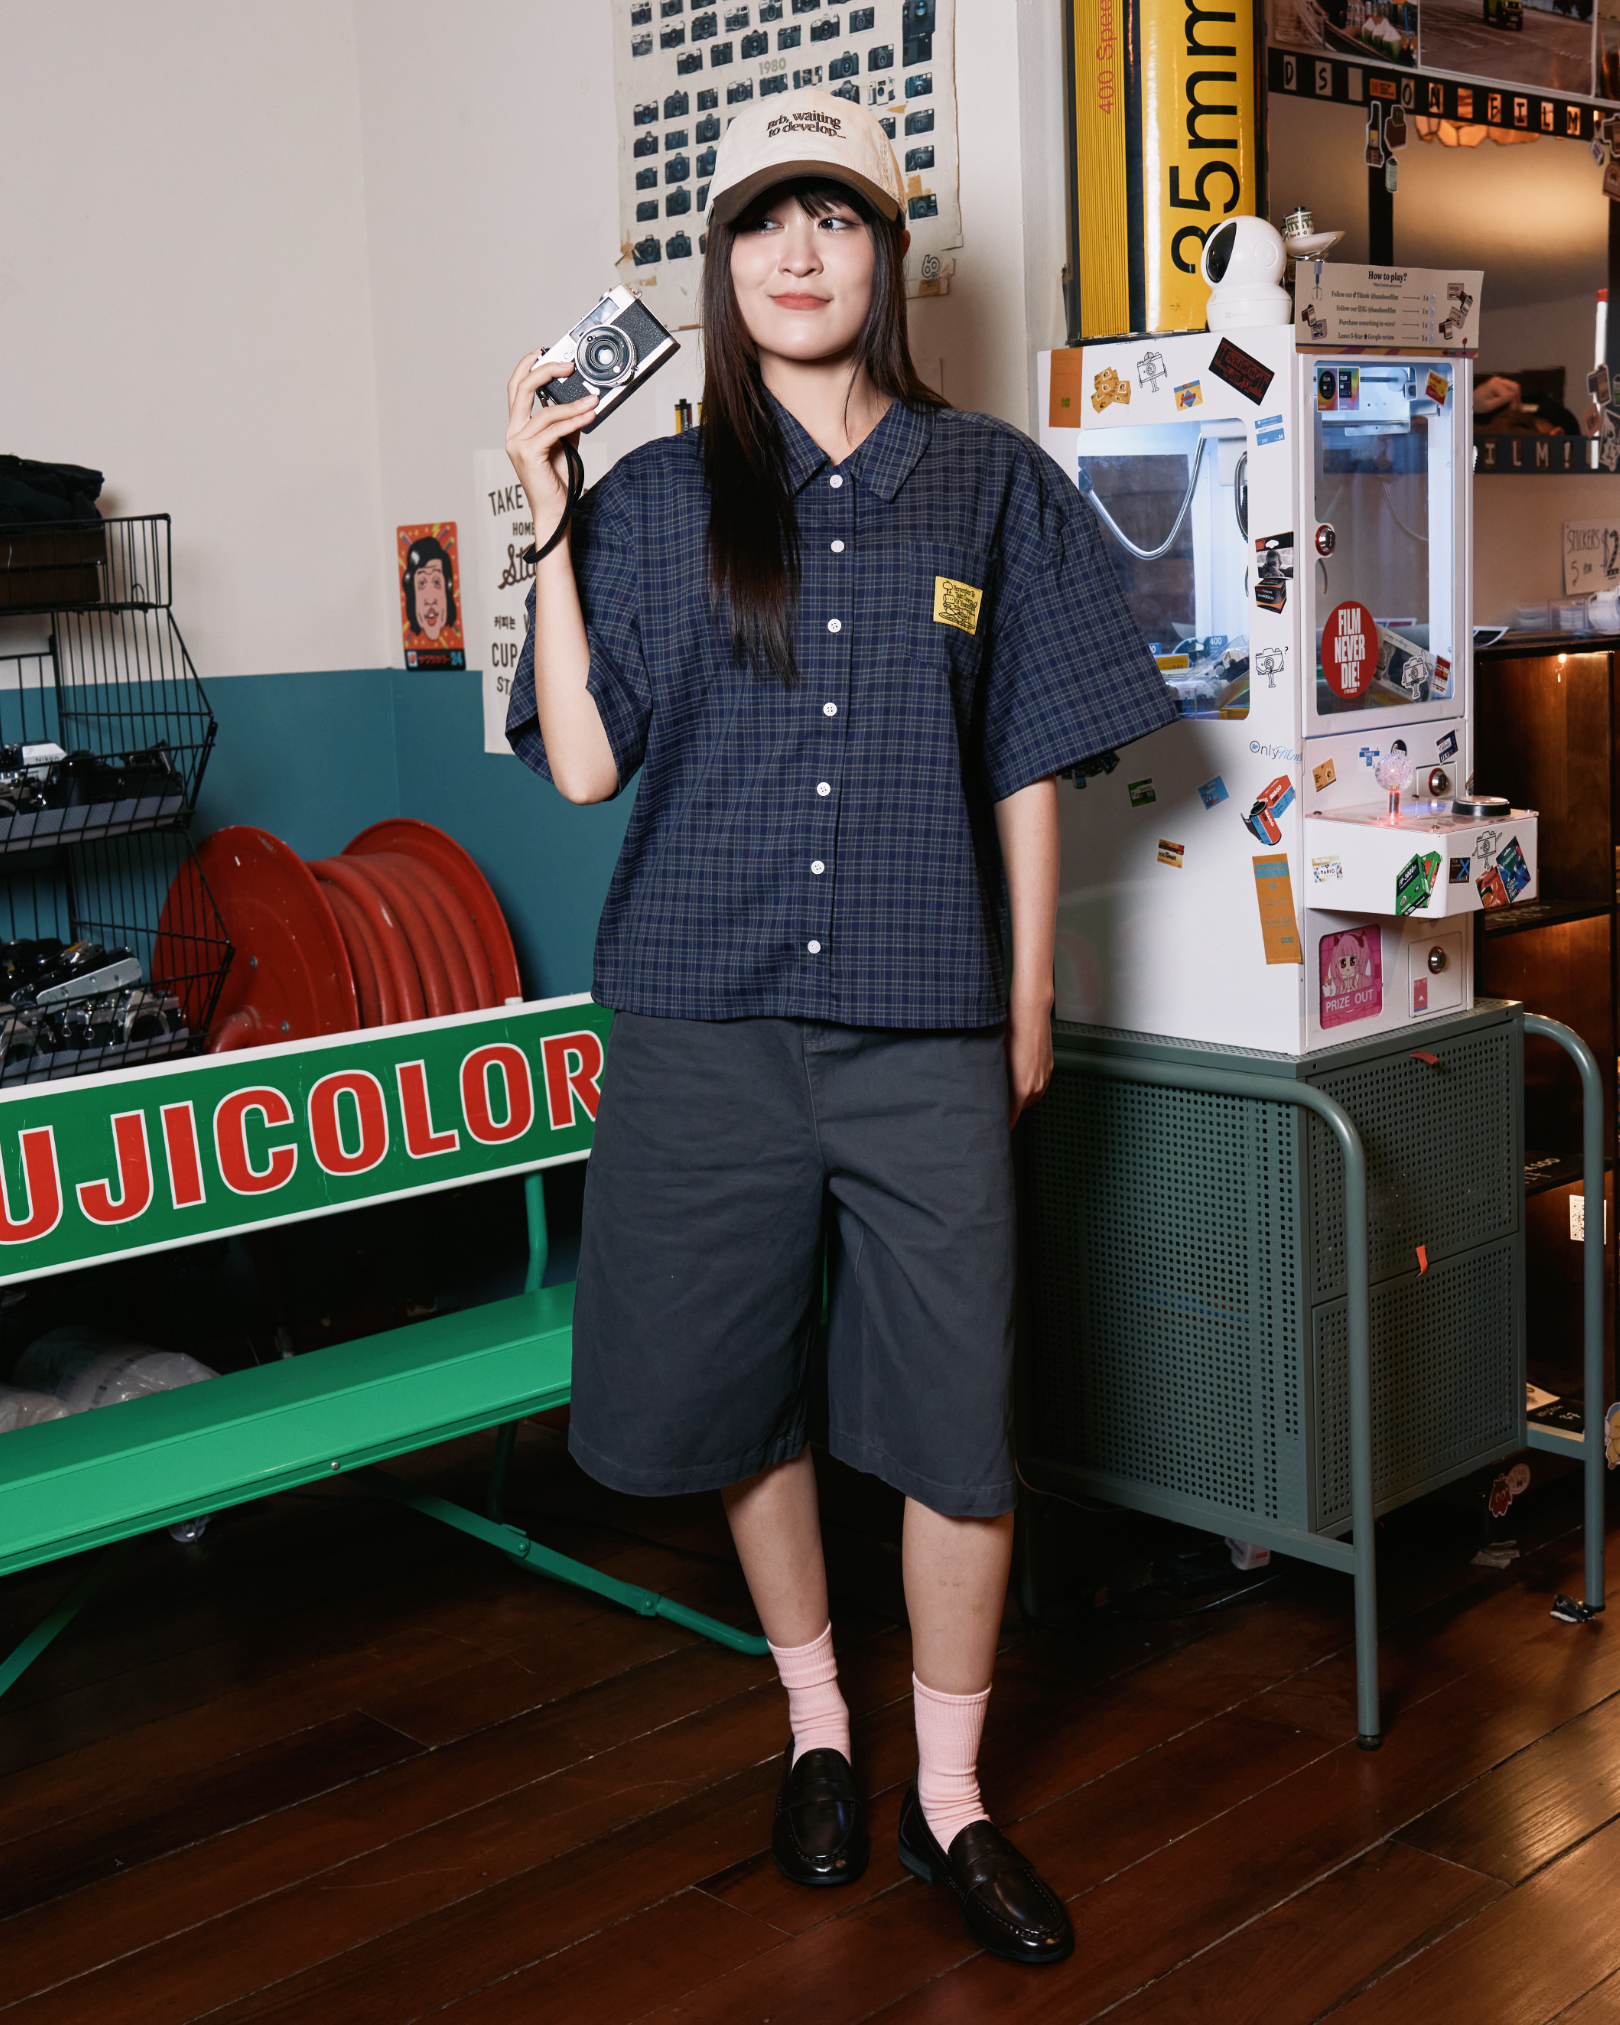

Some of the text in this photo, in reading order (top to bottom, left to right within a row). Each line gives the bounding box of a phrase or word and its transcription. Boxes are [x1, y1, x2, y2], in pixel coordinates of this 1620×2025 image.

[758, 57, 787, 76] 1980
[1096, 0, 1118, 115] 400 Spee
[792, 110, 842, 130] waiting
[1490, 96, 1581, 135] FILM
[768, 121, 846, 139] to develop...
[1368, 271, 1408, 284] How to play?
[1331, 290, 1345, 298] Follow
[1358, 320, 1379, 328] something
[1338, 332, 1350, 340] Leave
[1367, 333, 1382, 341] Google
[1223, 365, 1253, 393] FILM
[1225, 351, 1270, 392] SHOOT
[488, 483, 523, 516] TAKE
[512, 521, 535, 536] HOME
[1567, 528, 1600, 554] STICKERS
[1571, 560, 1580, 587] 5
[494, 616, 516, 630] 커피는
[1338, 608, 1361, 636] FILM
[1209, 637, 1223, 646] 400
[1334, 634, 1366, 663] NEVER
[450, 651, 463, 666] 24
[491, 642, 518, 668] CUP
[1341, 661, 1360, 689] DIE!
[35, 755, 60, 763] Nikon
[1325, 989, 1374, 1013] PRIZE OUT
[0, 1030, 604, 1245] UJICOLOR
